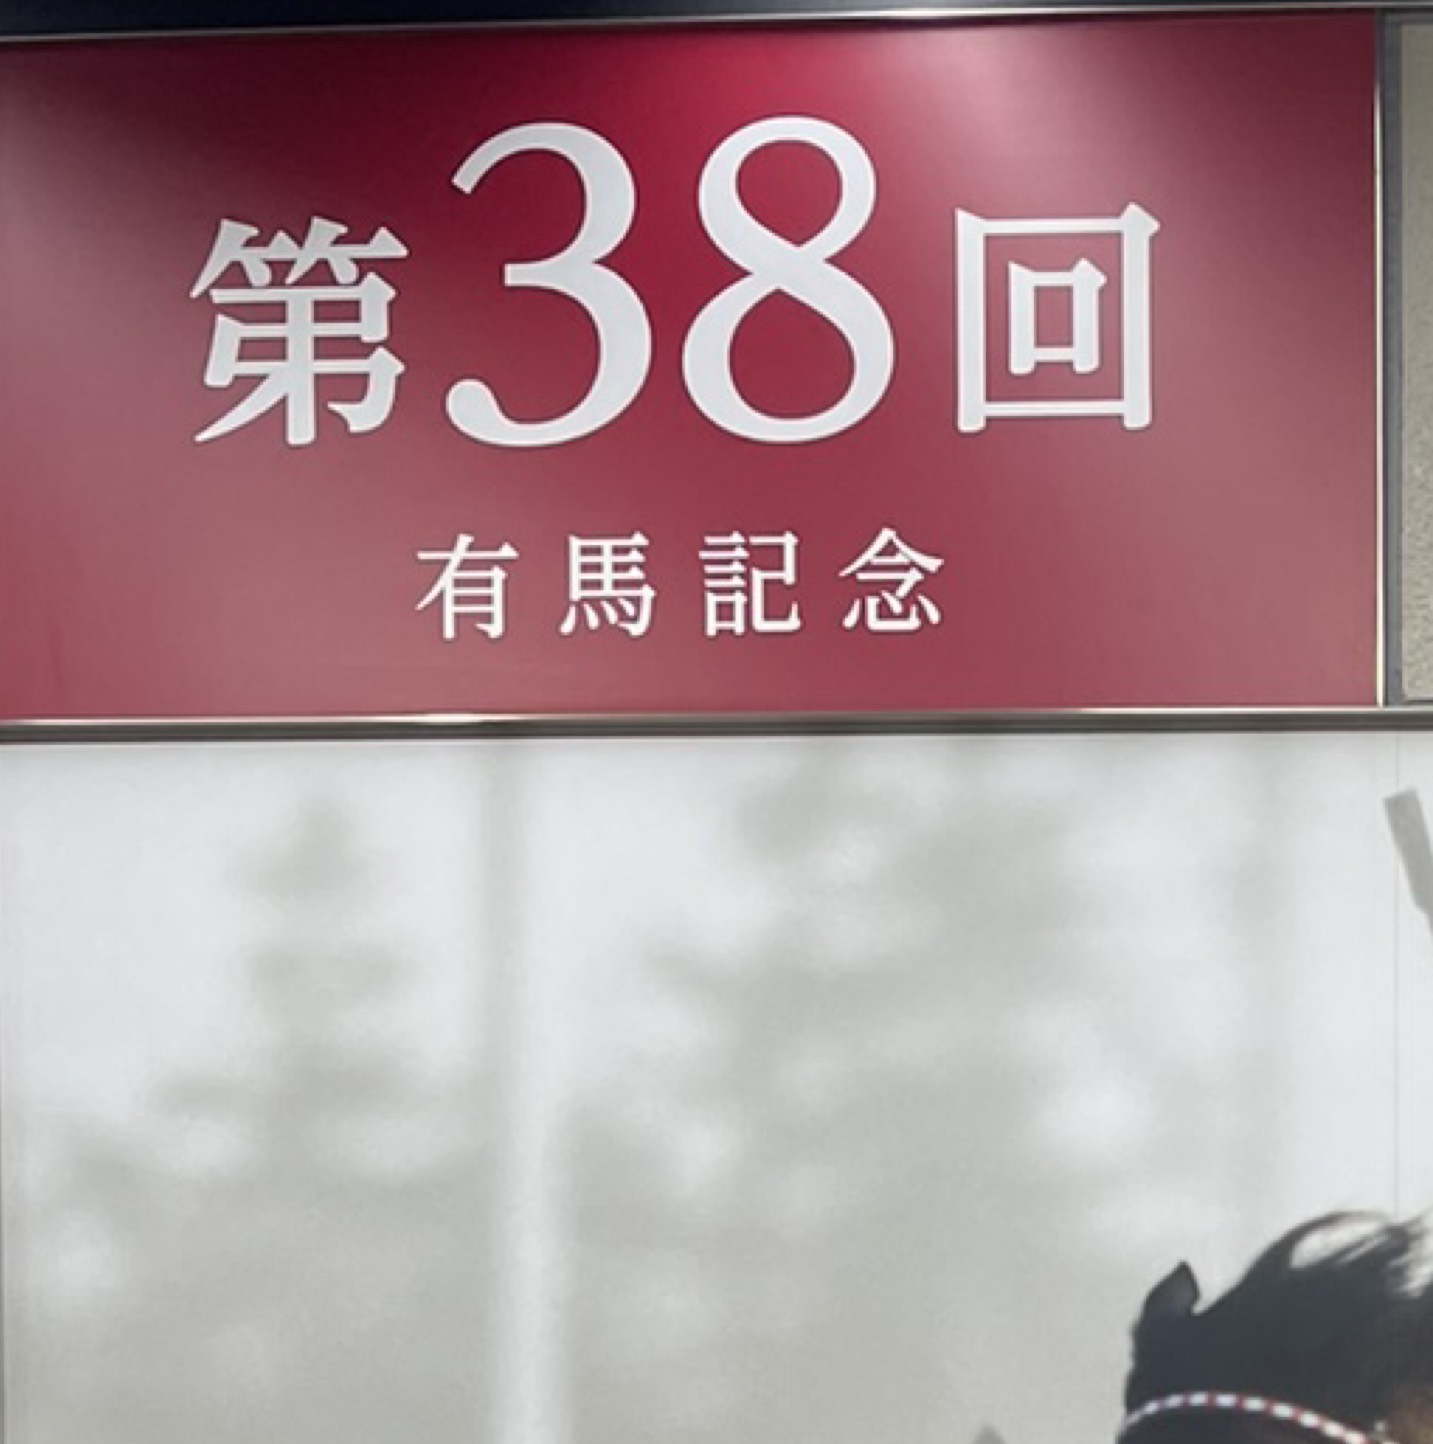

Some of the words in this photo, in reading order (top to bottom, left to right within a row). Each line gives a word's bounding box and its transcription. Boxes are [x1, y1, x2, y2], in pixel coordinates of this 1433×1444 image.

[188, 115, 1161, 447] 第38回
[414, 528, 945, 640] 有馬記念
